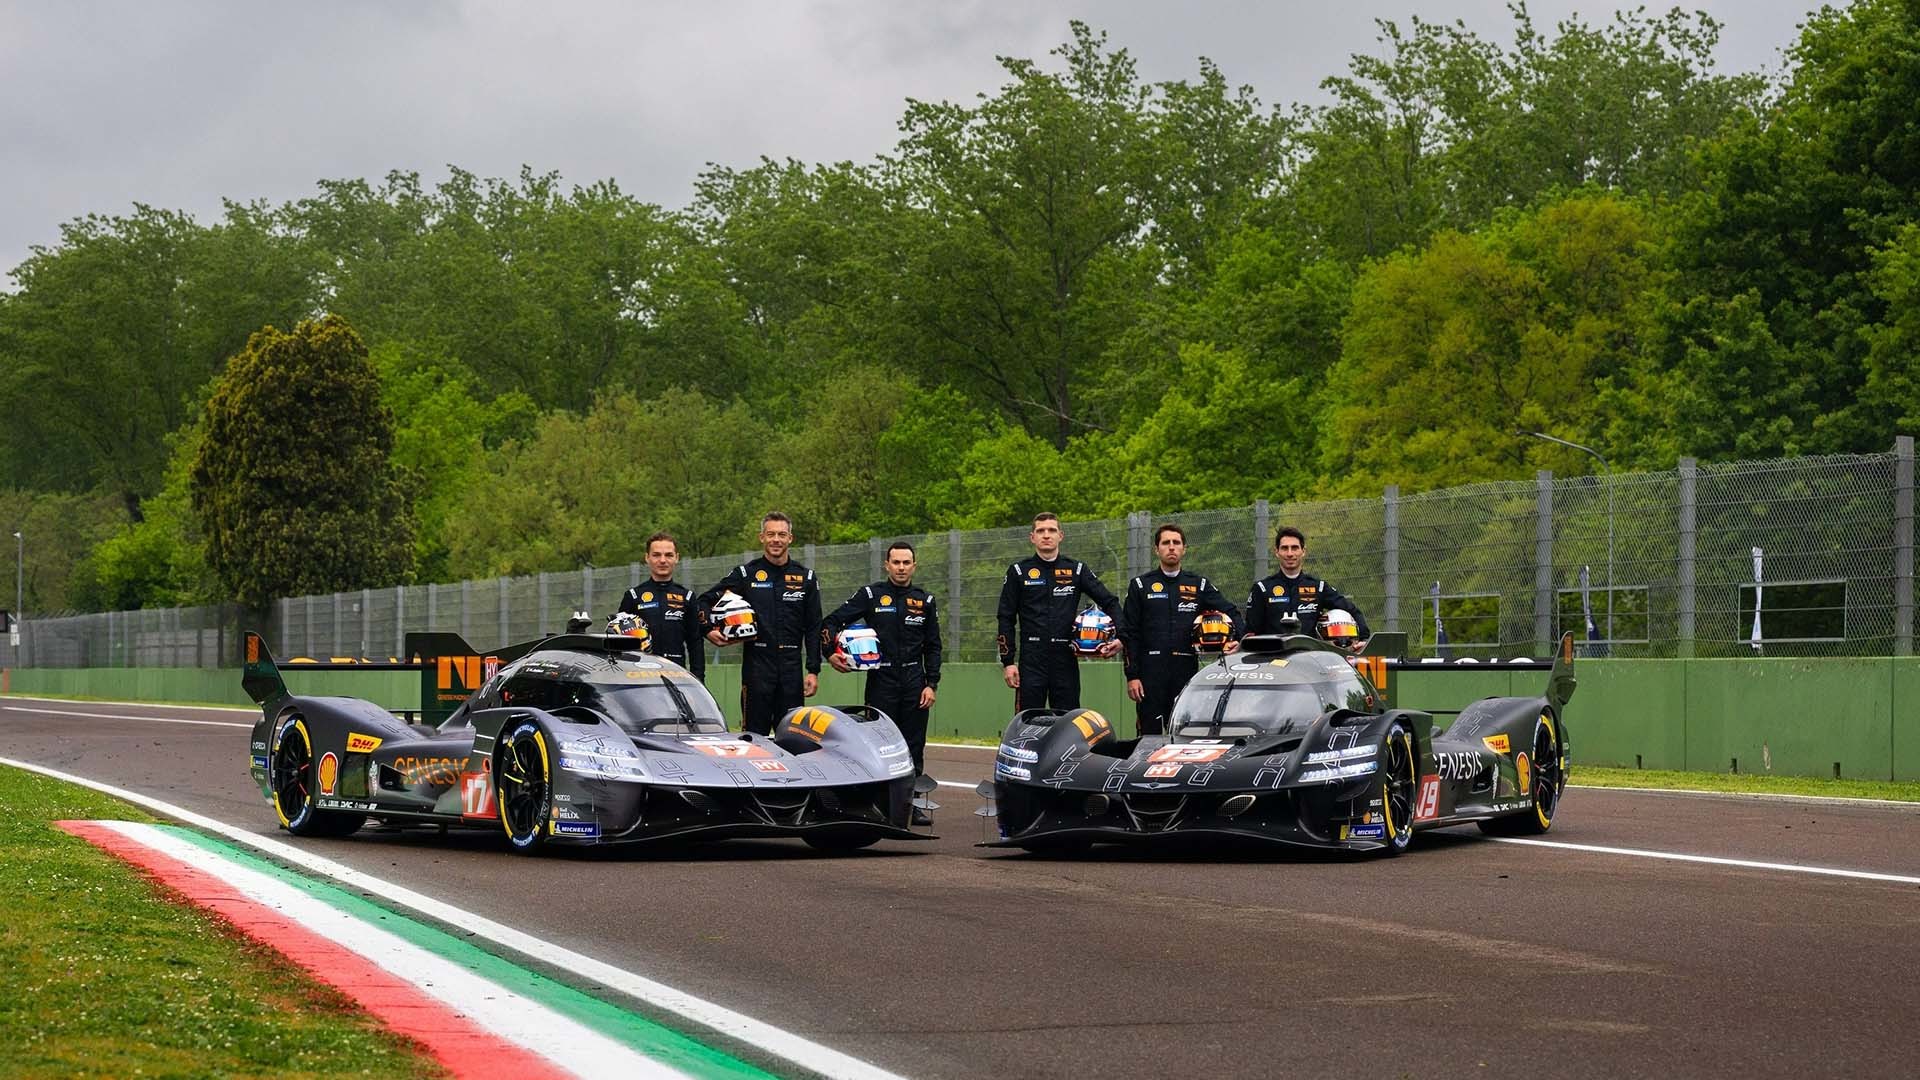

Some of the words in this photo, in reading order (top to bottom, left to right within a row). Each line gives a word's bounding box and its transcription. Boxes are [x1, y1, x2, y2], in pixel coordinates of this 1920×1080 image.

[1206, 672, 1275, 680] GENESIS
[352, 738, 375, 749] DHL
[755, 760, 782, 770] HY
[1432, 751, 1483, 780] ENESIS
[1149, 766, 1175, 776] HY
[466, 778, 488, 814] 17
[1415, 781, 1439, 818] 19
